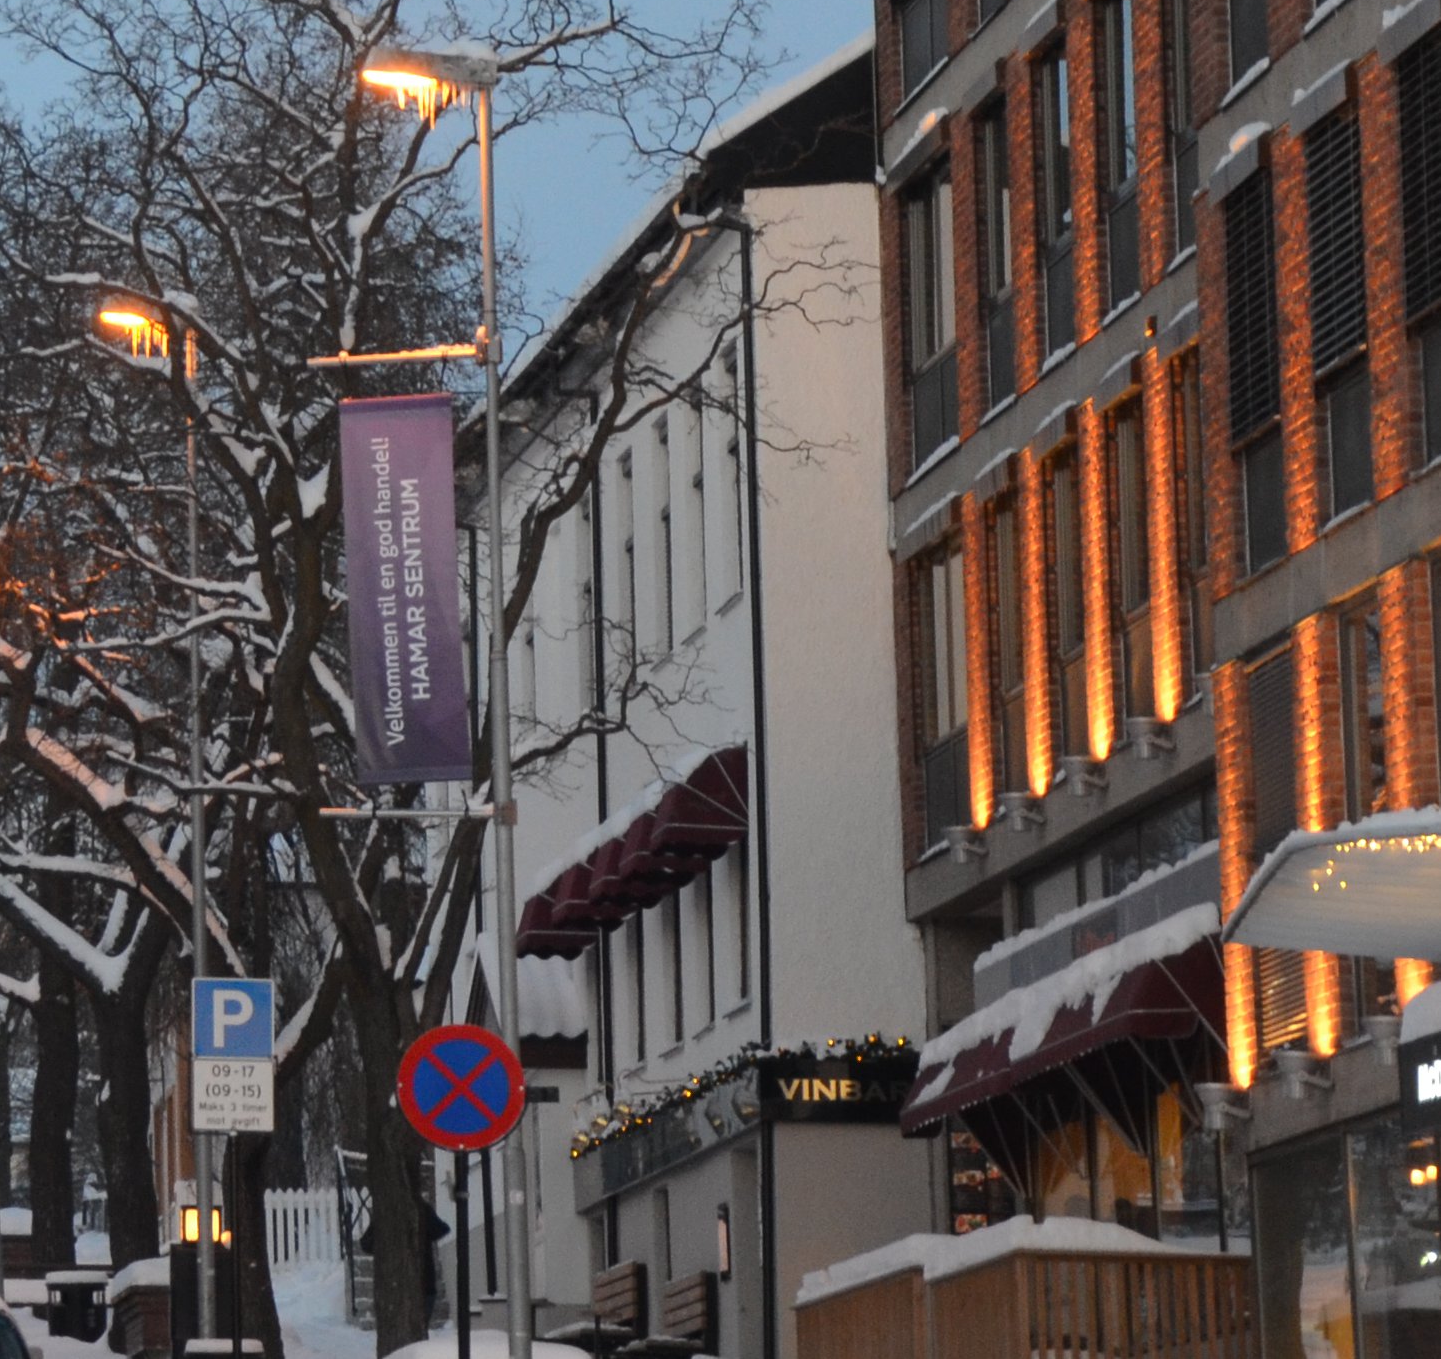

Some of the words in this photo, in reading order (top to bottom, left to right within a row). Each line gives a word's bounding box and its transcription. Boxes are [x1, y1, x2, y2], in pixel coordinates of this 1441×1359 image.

[370, 437, 391, 514] handel!
[374, 519, 398, 558] god
[400, 478, 424, 598] SENTRUM
[377, 594, 396, 617] til
[380, 563, 395, 589] en
[406, 607, 431, 700] HAMAR
[383, 622, 405, 746] Velkommen
[213, 989, 253, 1048] P
[199, 1102, 225, 1111] Maks
